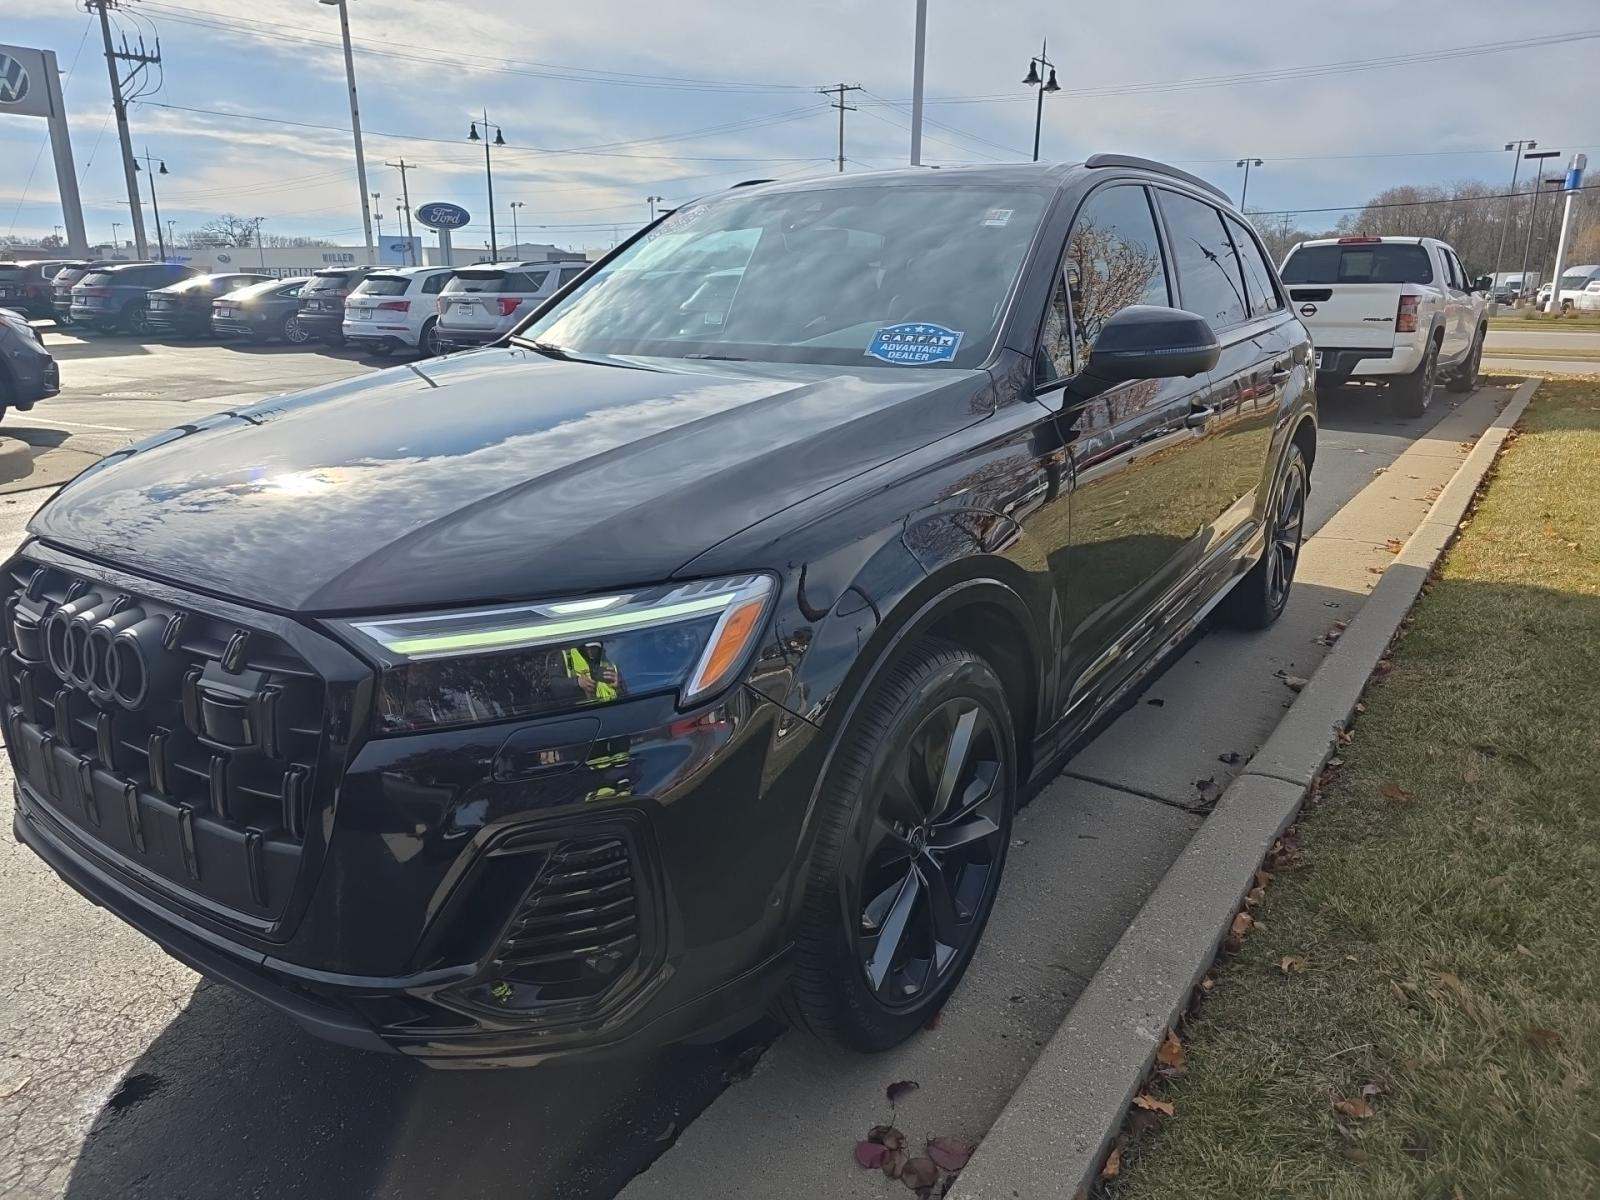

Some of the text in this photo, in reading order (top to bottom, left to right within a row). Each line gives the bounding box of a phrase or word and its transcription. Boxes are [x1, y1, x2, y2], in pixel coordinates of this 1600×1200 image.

[430, 207, 461, 224] Ford
[881, 334, 954, 346] CARFAX
[880, 343, 943, 354] ADVANTAGE
[888, 352, 929, 361] DEALER
